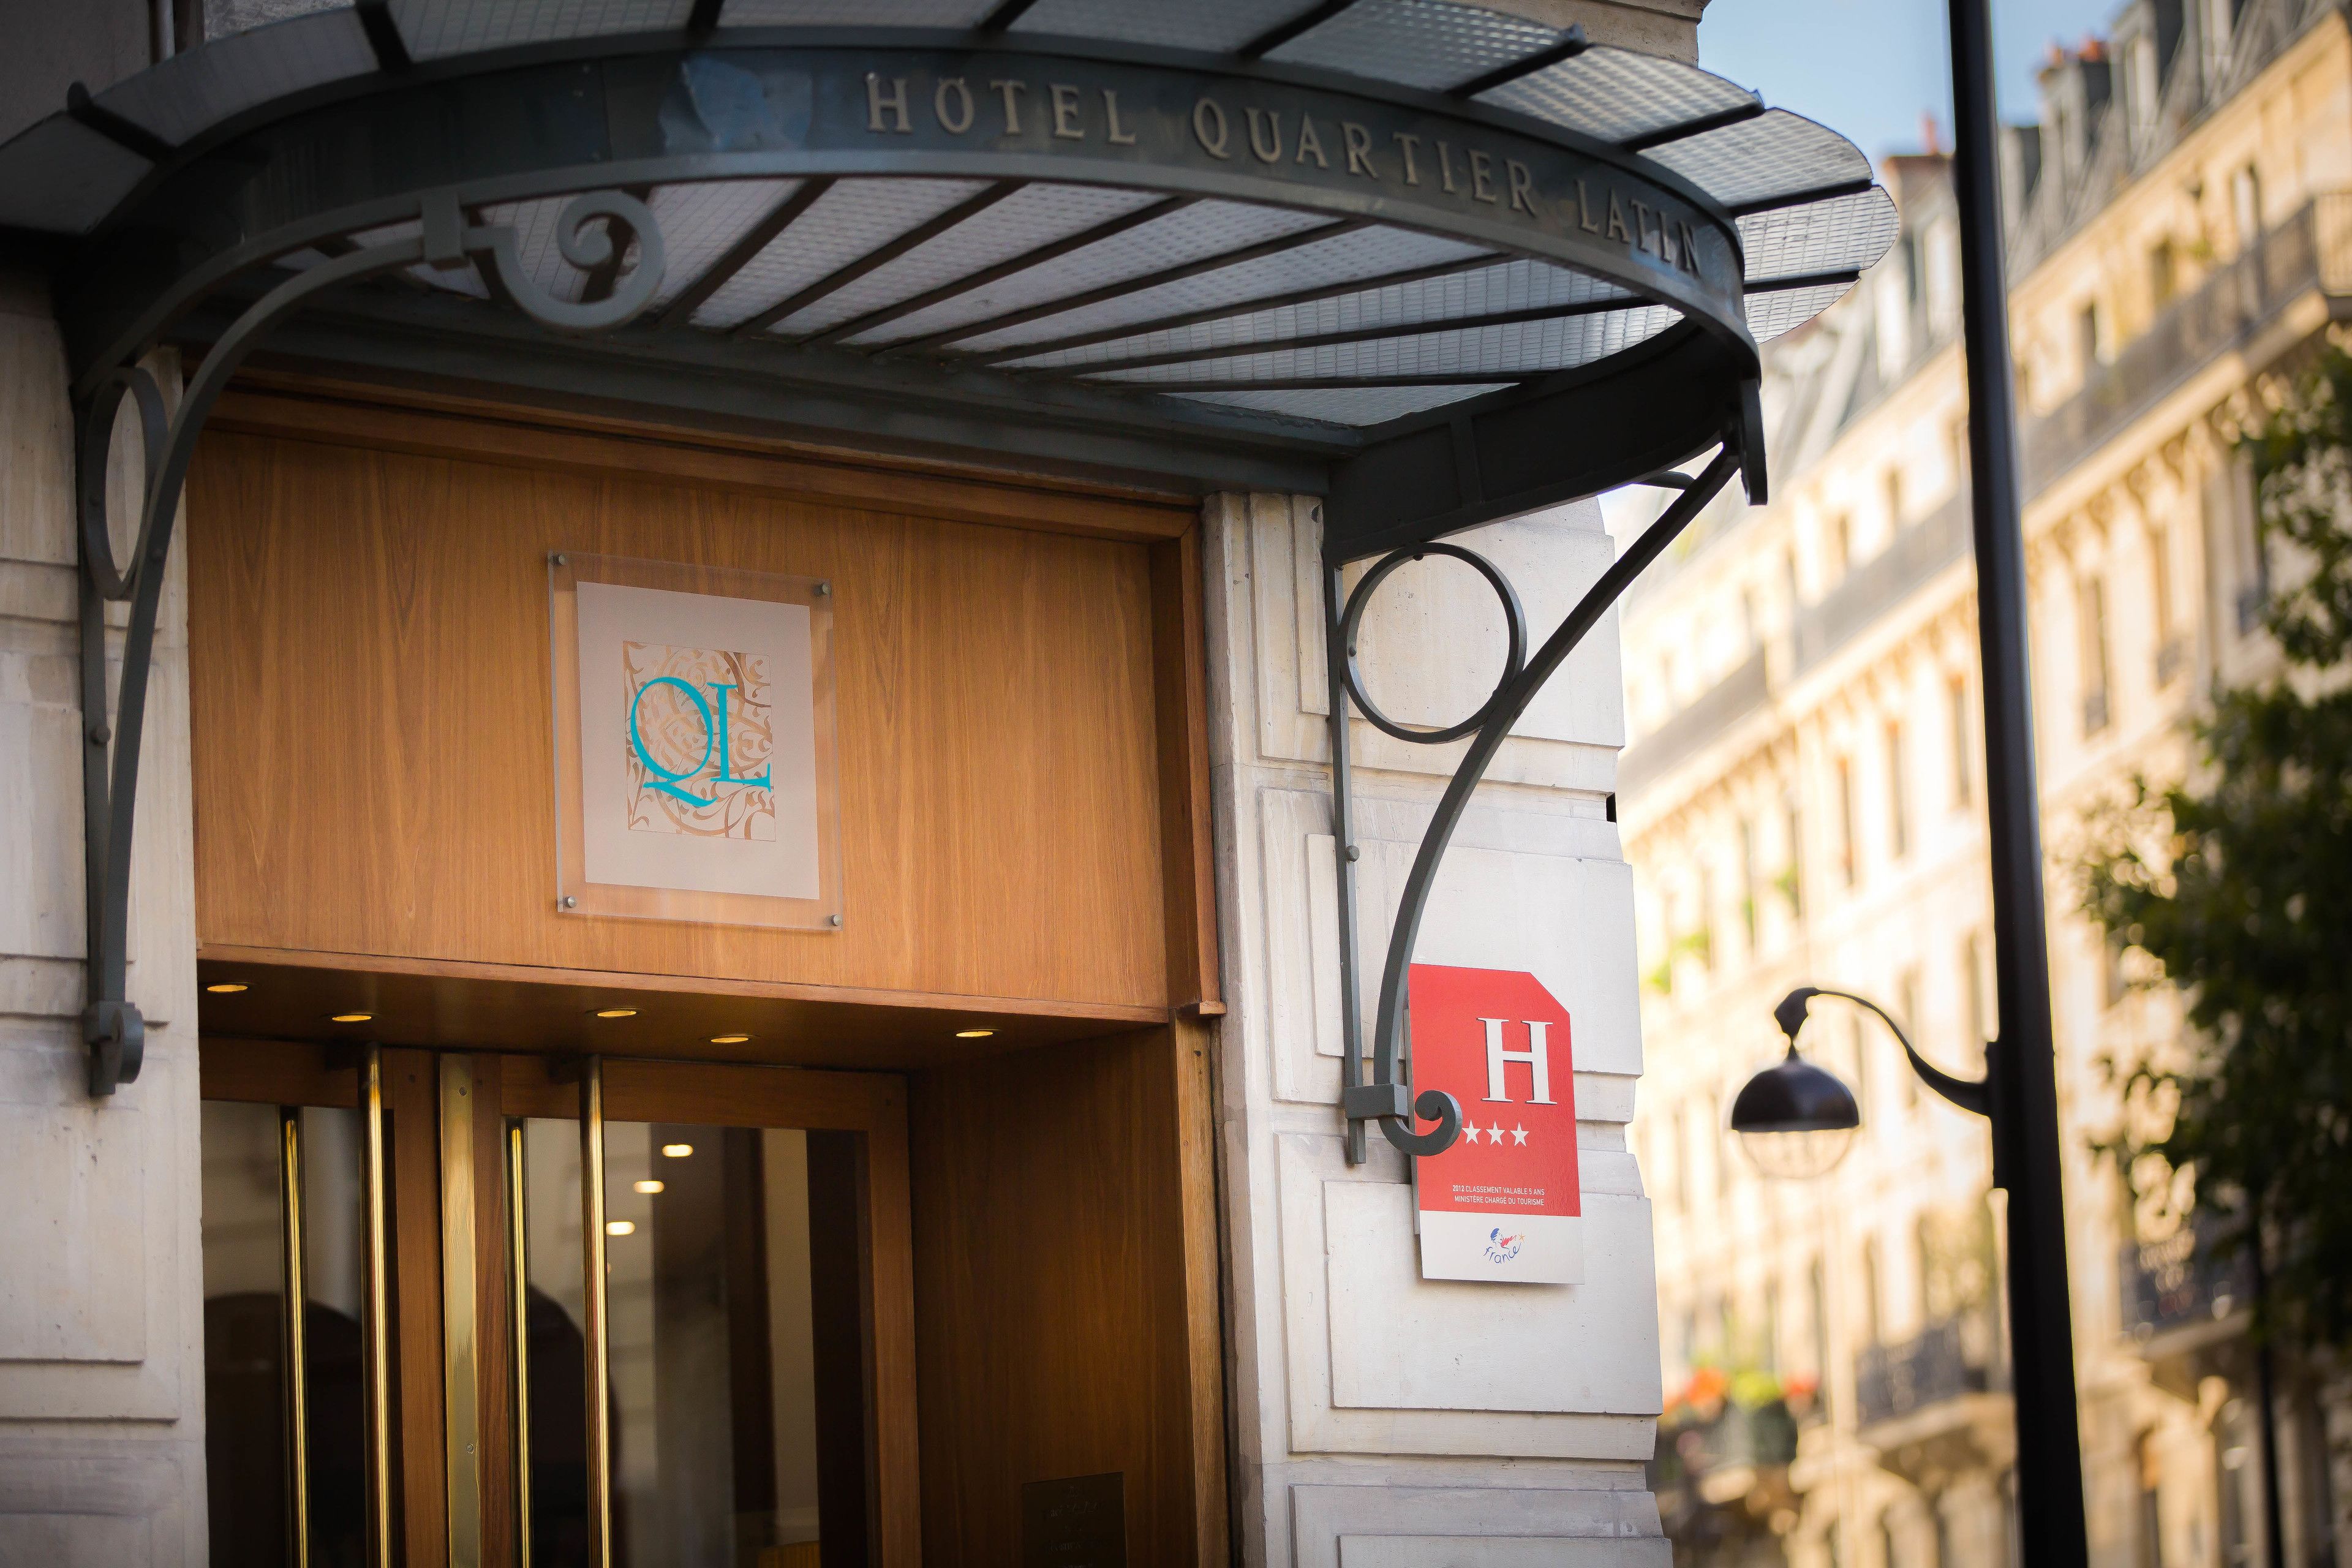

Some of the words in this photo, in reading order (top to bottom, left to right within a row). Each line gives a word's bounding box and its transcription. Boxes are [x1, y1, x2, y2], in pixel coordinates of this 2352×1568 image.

[1191, 97, 1538, 217] QUARTIER
[1575, 178, 1702, 279] LATIN
[630, 676, 772, 808] QL
[1476, 1017, 1558, 1105] H
[1454, 1194, 1483, 1203] MINISTÈRE
[1485, 1196, 1507, 1204] CHARGÉ
[1517, 1197, 1544, 1206] TOURISME
[1466, 1185, 1502, 1194] CLASSEMENT
[1503, 1186, 1528, 1195] VALABLE
